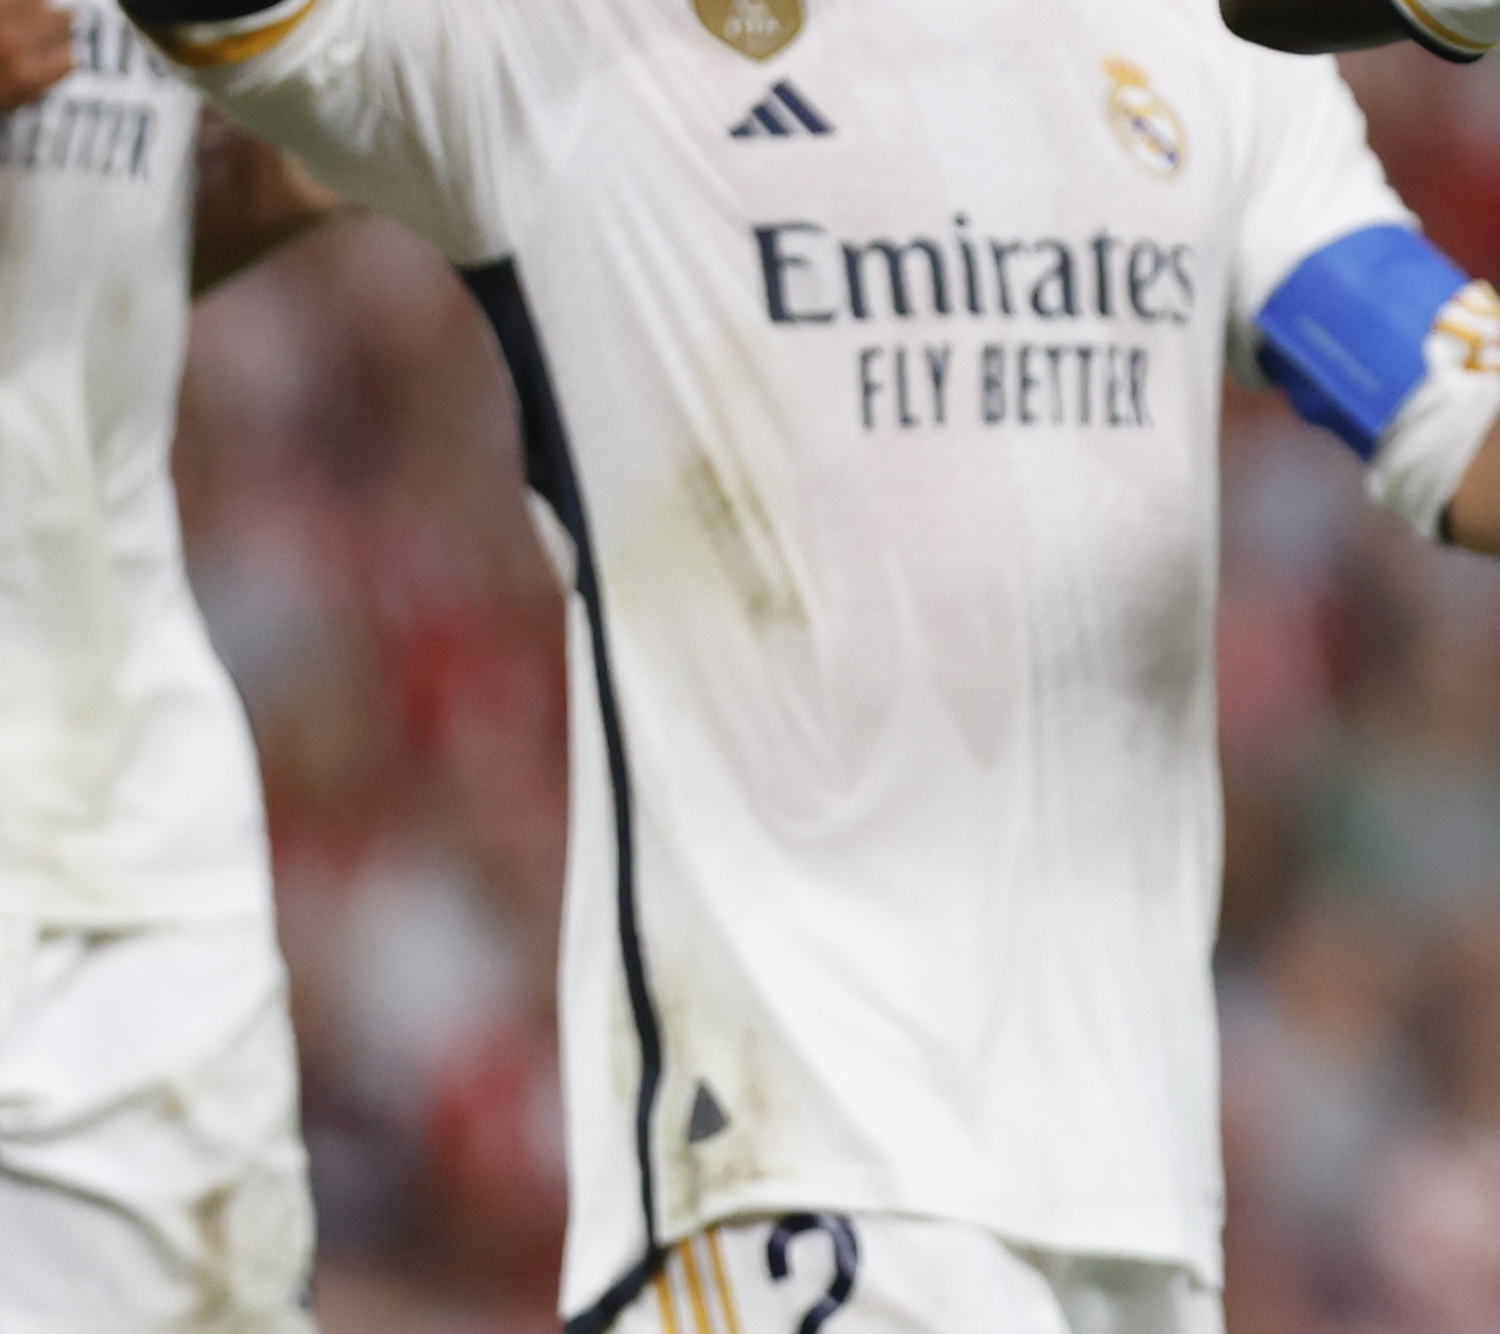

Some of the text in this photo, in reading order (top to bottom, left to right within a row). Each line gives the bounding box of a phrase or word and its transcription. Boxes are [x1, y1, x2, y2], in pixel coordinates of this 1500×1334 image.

[751, 212, 1197, 328] Emirates
[858, 344, 1153, 433] FLY BETTER
